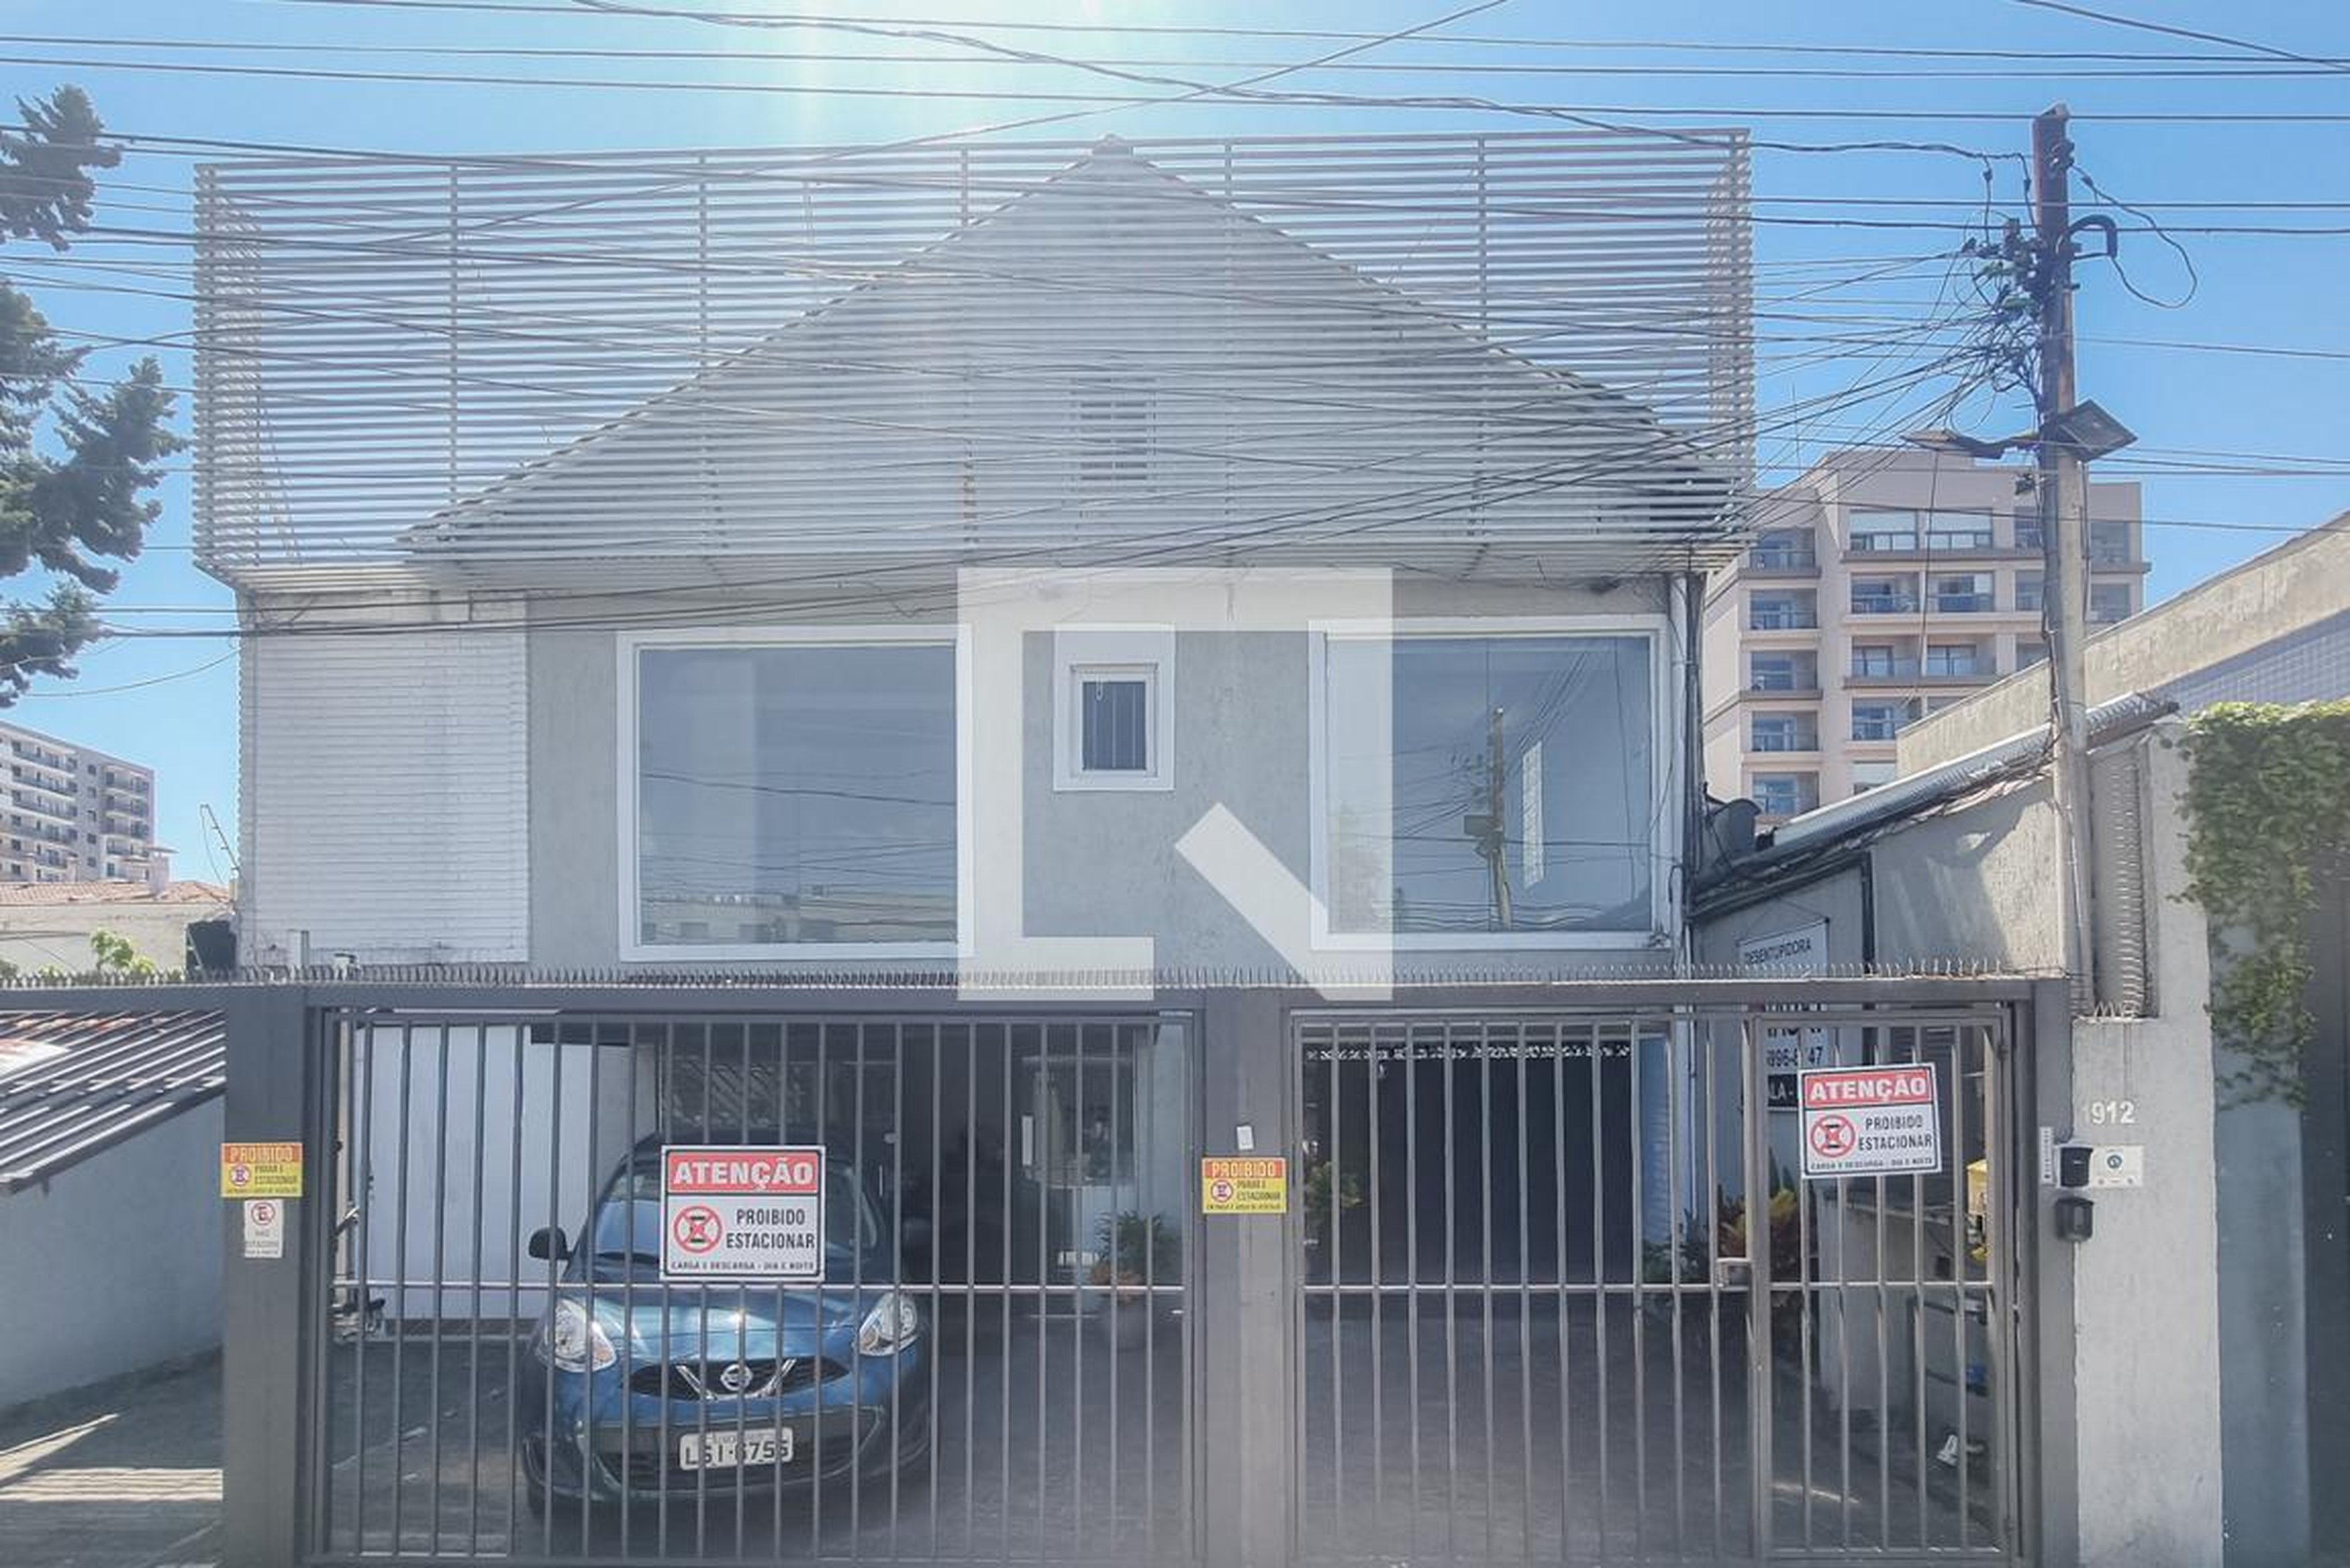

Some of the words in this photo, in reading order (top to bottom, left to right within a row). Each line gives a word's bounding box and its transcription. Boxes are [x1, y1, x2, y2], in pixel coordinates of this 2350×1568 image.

[1810, 1075, 1927, 1101] ATENÇÃO
[2091, 1101, 2135, 1124] 912
[1866, 1115, 1923, 1130] PROIBIDO
[1859, 1135, 1933, 1151] ESTACIONAR
[673, 1157, 813, 1189] ATENÇÃO
[1211, 1162, 1275, 1177] PROIBIDO
[736, 1209, 805, 1225] PROIBIDO
[726, 1233, 815, 1249] ESTACIONAR
[671, 1261, 699, 1270] CARGA
[710, 1261, 755, 1270] DESCARGA
[789, 1261, 814, 1270] NOITE
